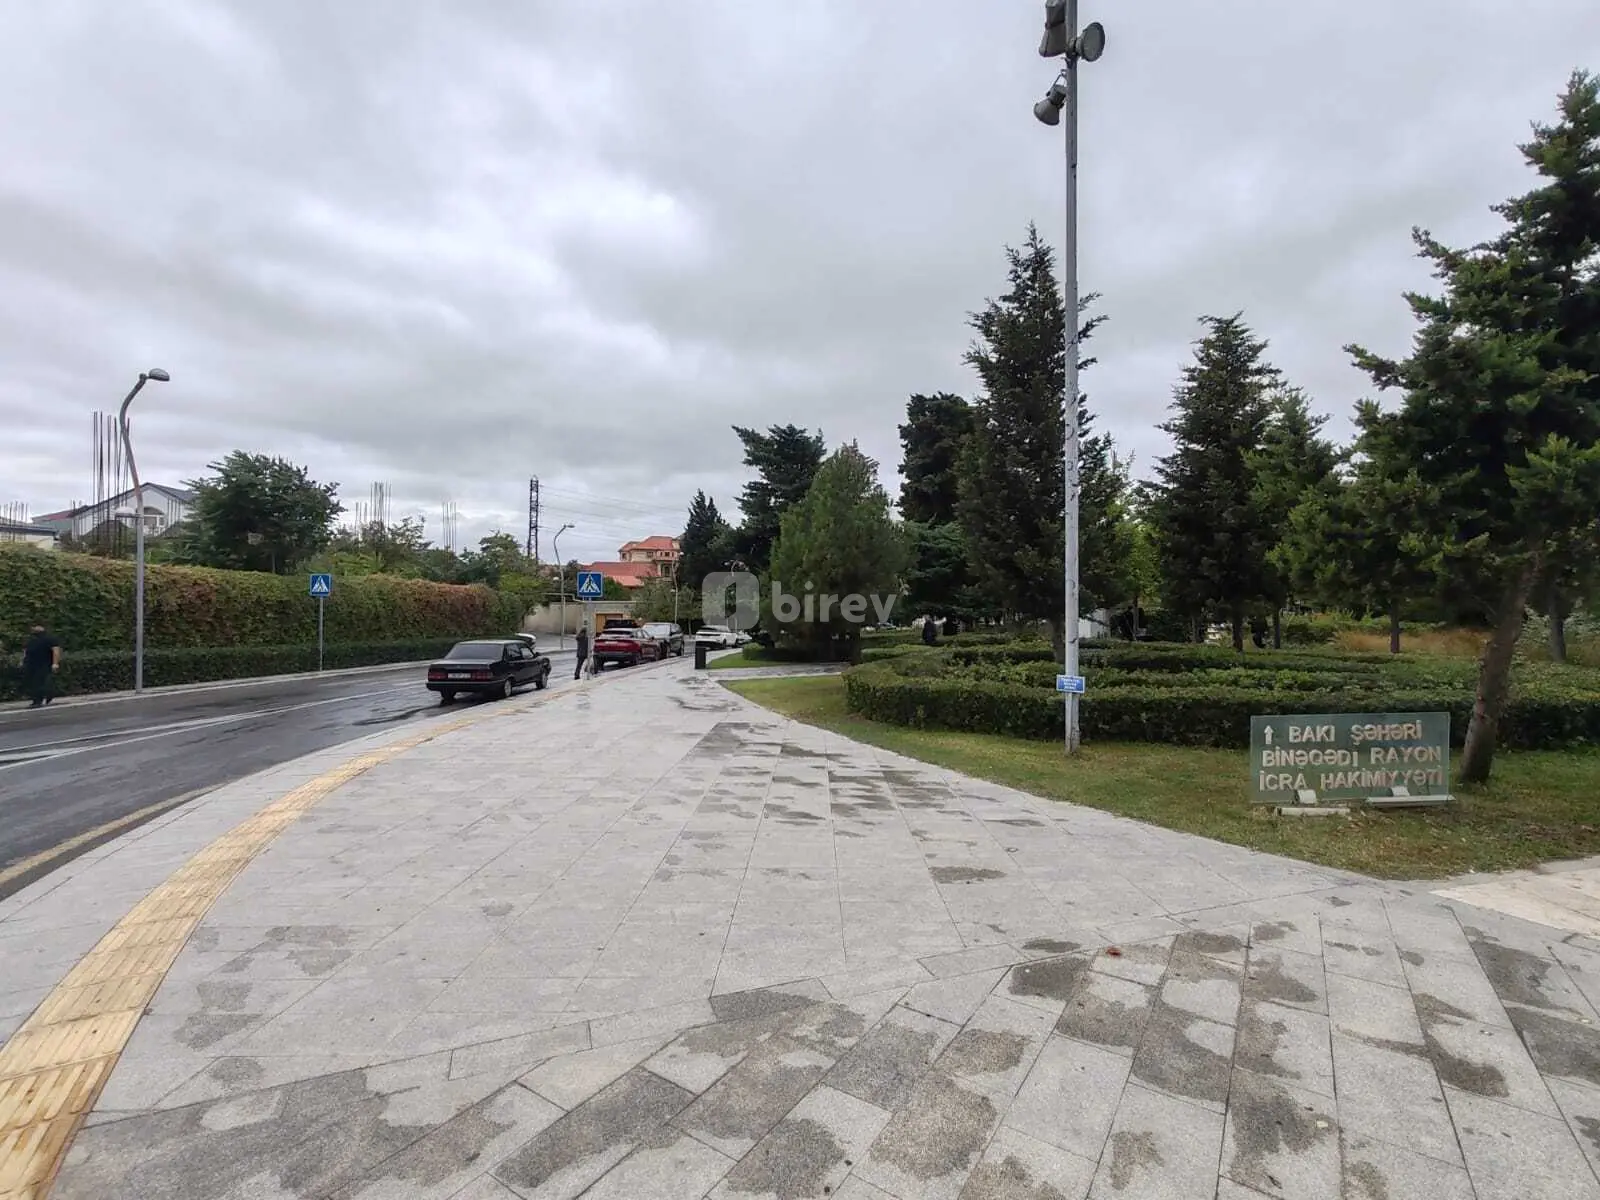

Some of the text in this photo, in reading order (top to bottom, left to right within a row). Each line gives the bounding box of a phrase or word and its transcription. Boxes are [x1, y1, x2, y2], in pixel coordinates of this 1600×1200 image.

[1289, 720, 1422, 745] BAKI ŞƏHƏRİ
[1370, 745, 1441, 764] RAYON
[1259, 770, 1308, 790] İCRA
